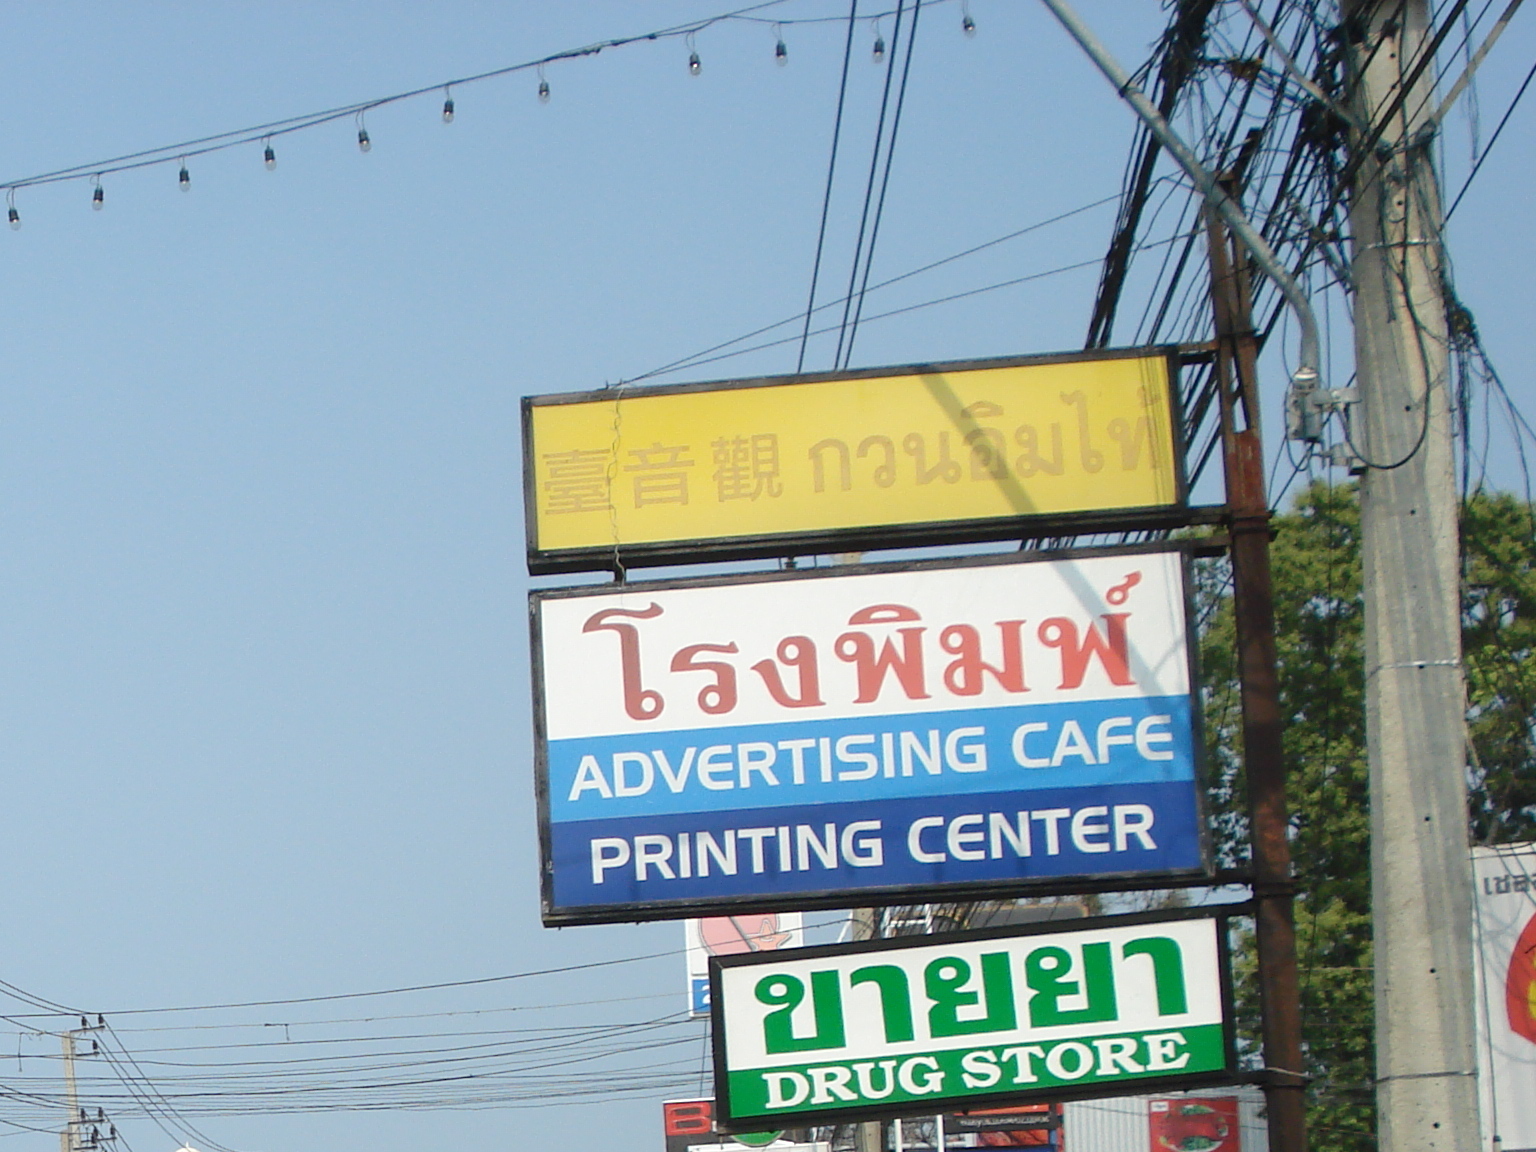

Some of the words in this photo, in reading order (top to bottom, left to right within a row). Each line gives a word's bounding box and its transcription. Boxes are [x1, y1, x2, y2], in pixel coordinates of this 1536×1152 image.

[582, 571, 1143, 721] โรงพิมพ์
[568, 725, 987, 801] ADVERTISING
[1012, 715, 1174, 768] CAFE
[590, 820, 883, 884] PRINTING
[907, 803, 1157, 863] CENTER
[754, 936, 1188, 1056] ขายยา
[762, 1053, 947, 1111] DRUG
[963, 1031, 1192, 1091] STORE
